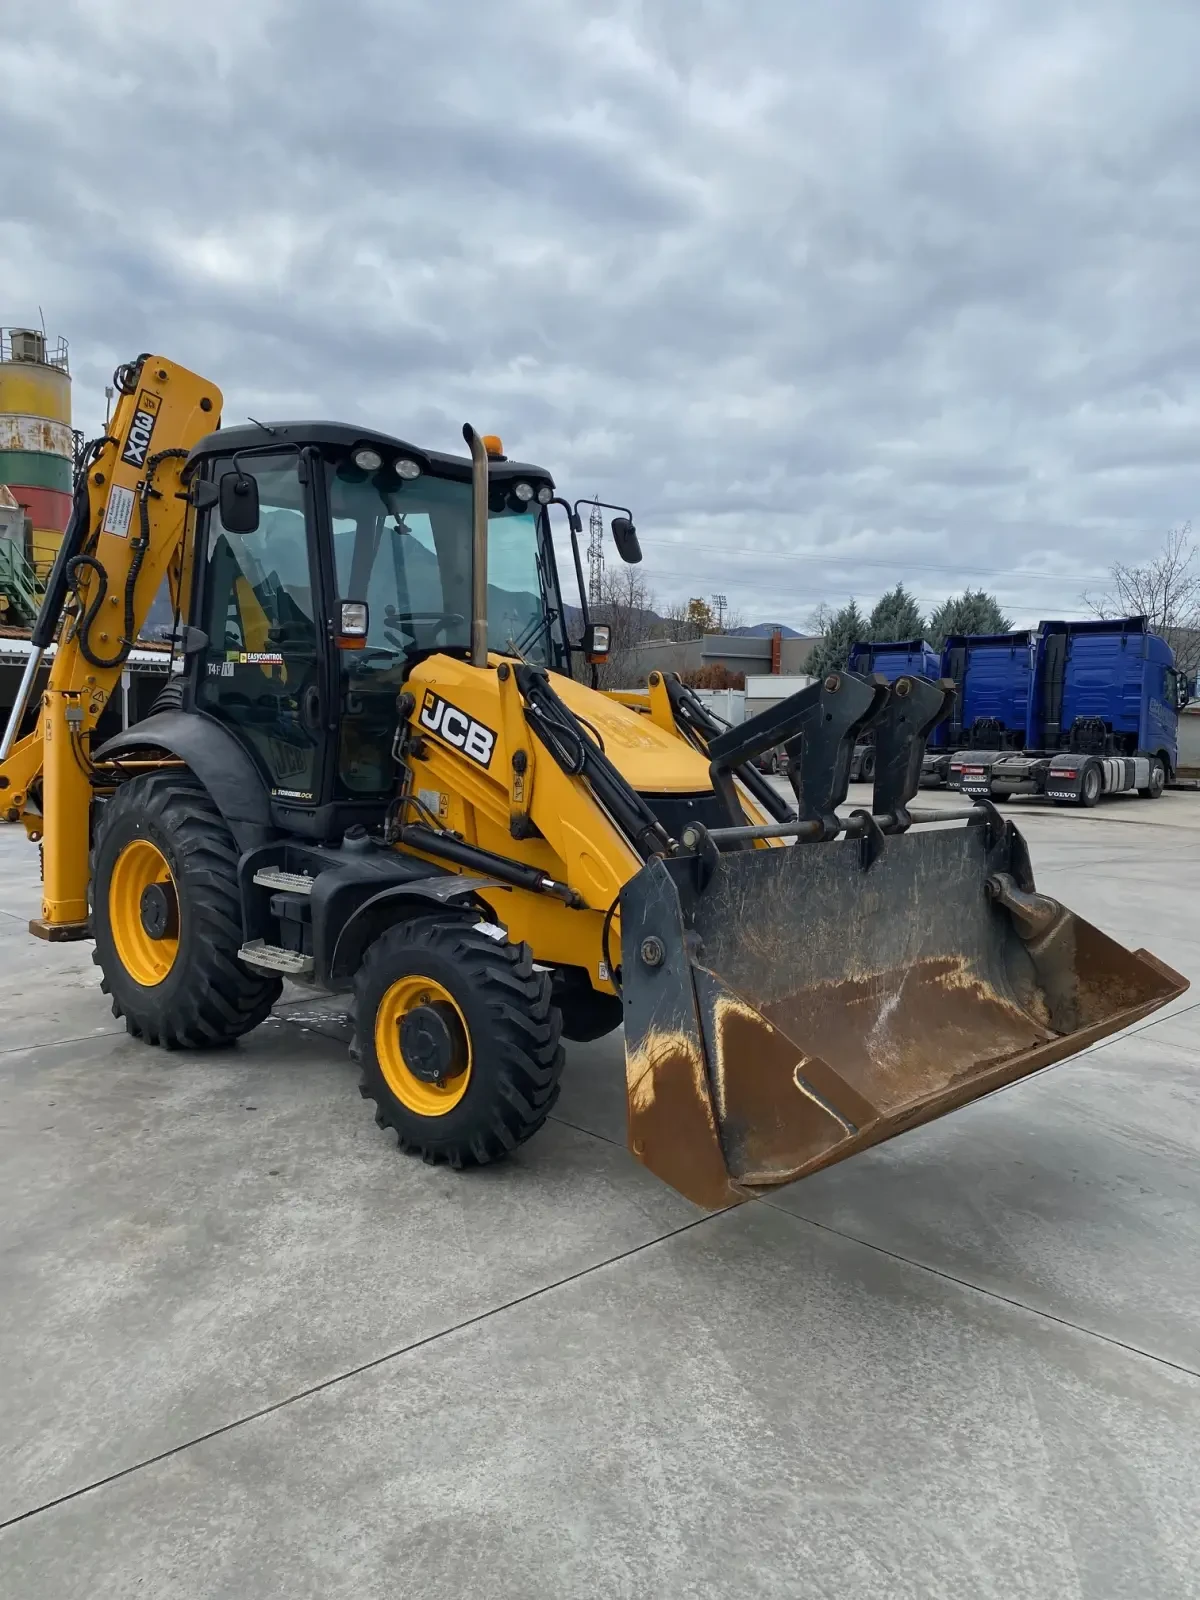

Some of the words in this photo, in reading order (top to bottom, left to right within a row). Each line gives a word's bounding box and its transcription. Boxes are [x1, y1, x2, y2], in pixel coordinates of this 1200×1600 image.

[124, 411, 154, 463] 3CX
[247, 653, 282, 662] EASYCONTROL
[421, 699, 494, 764] JCB
